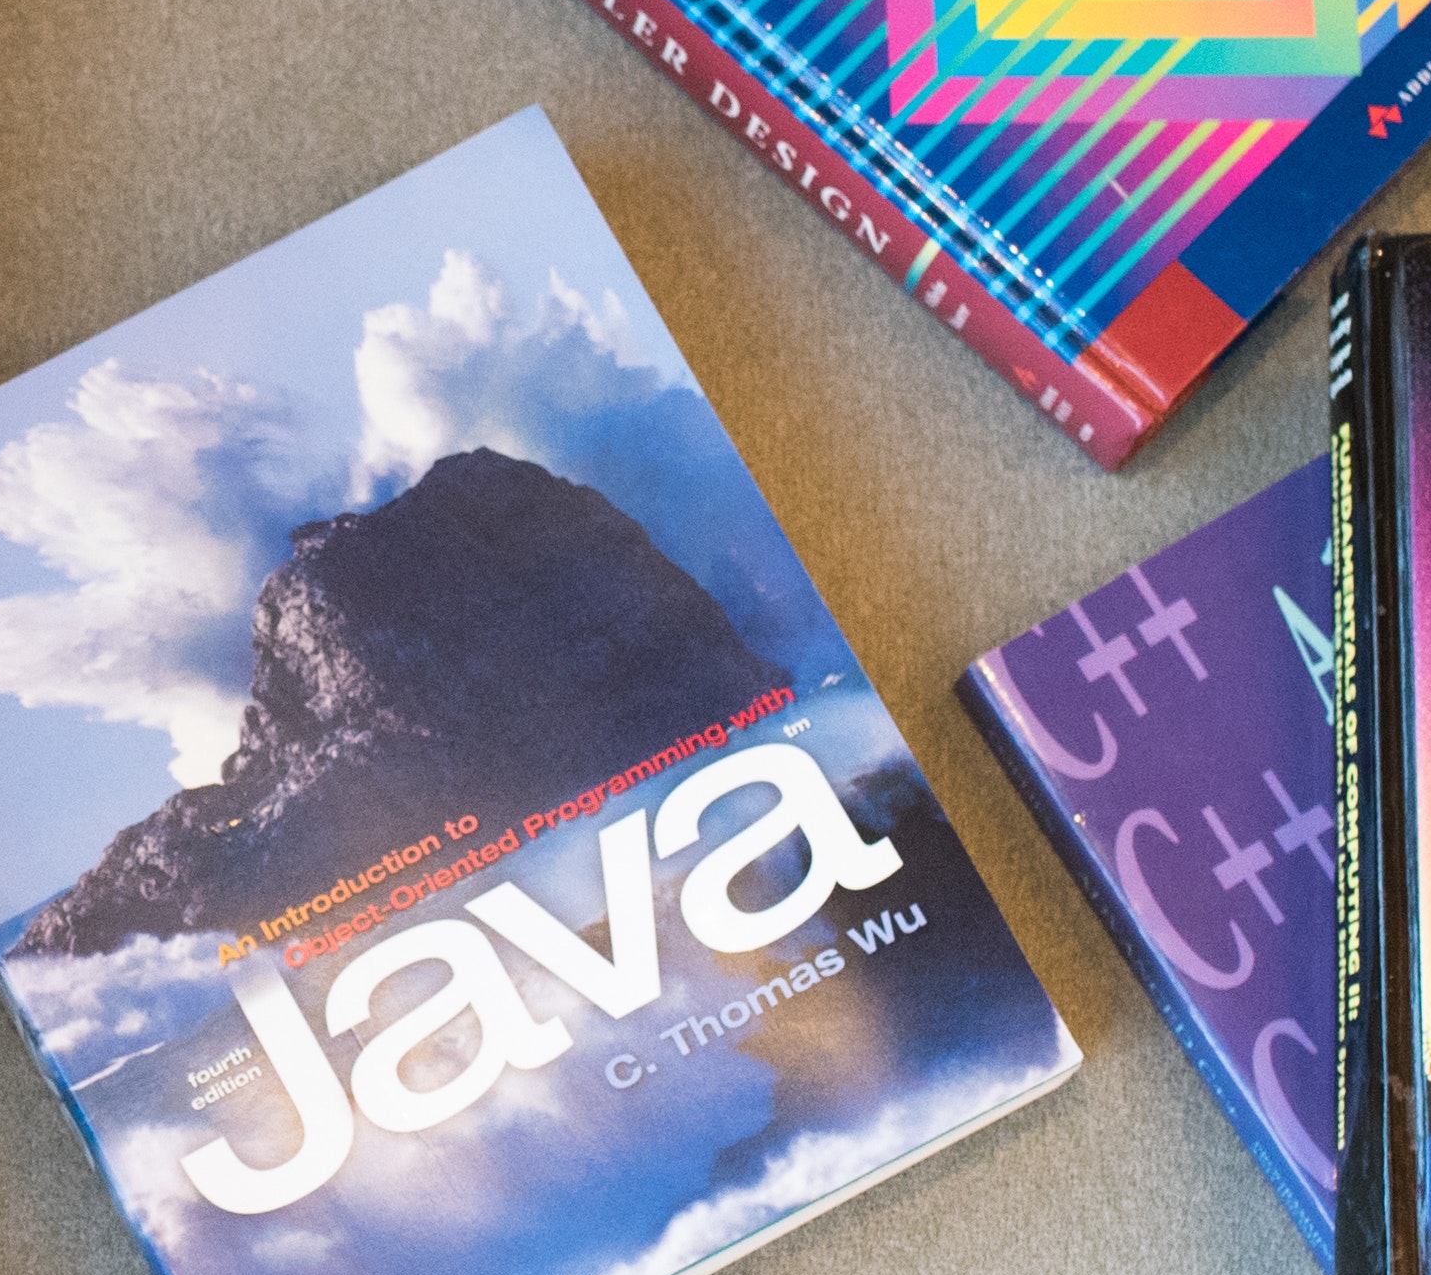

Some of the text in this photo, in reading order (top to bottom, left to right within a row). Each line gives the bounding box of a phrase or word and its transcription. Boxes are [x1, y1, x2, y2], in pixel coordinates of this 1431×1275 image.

[709, 81, 891, 254] DESIGN
[1339, 422, 1356, 704] FUNDAMENTALS
[783, 717, 812, 739] tm
[978, 564, 1209, 781] C++
[1345, 709, 1358, 756] OF
[217, 815, 478, 967] An Introduction to
[284, 687, 796, 968] Object-Oriented Programming with
[1115, 769, 1336, 990] C++
[1345, 762, 1360, 976] COMPUTING
[180, 743, 903, 1215] Java
[187, 1046, 252, 1088] fourth
[604, 903, 927, 1091] C. Thomas Wu
[191, 1063, 262, 1111] edition
